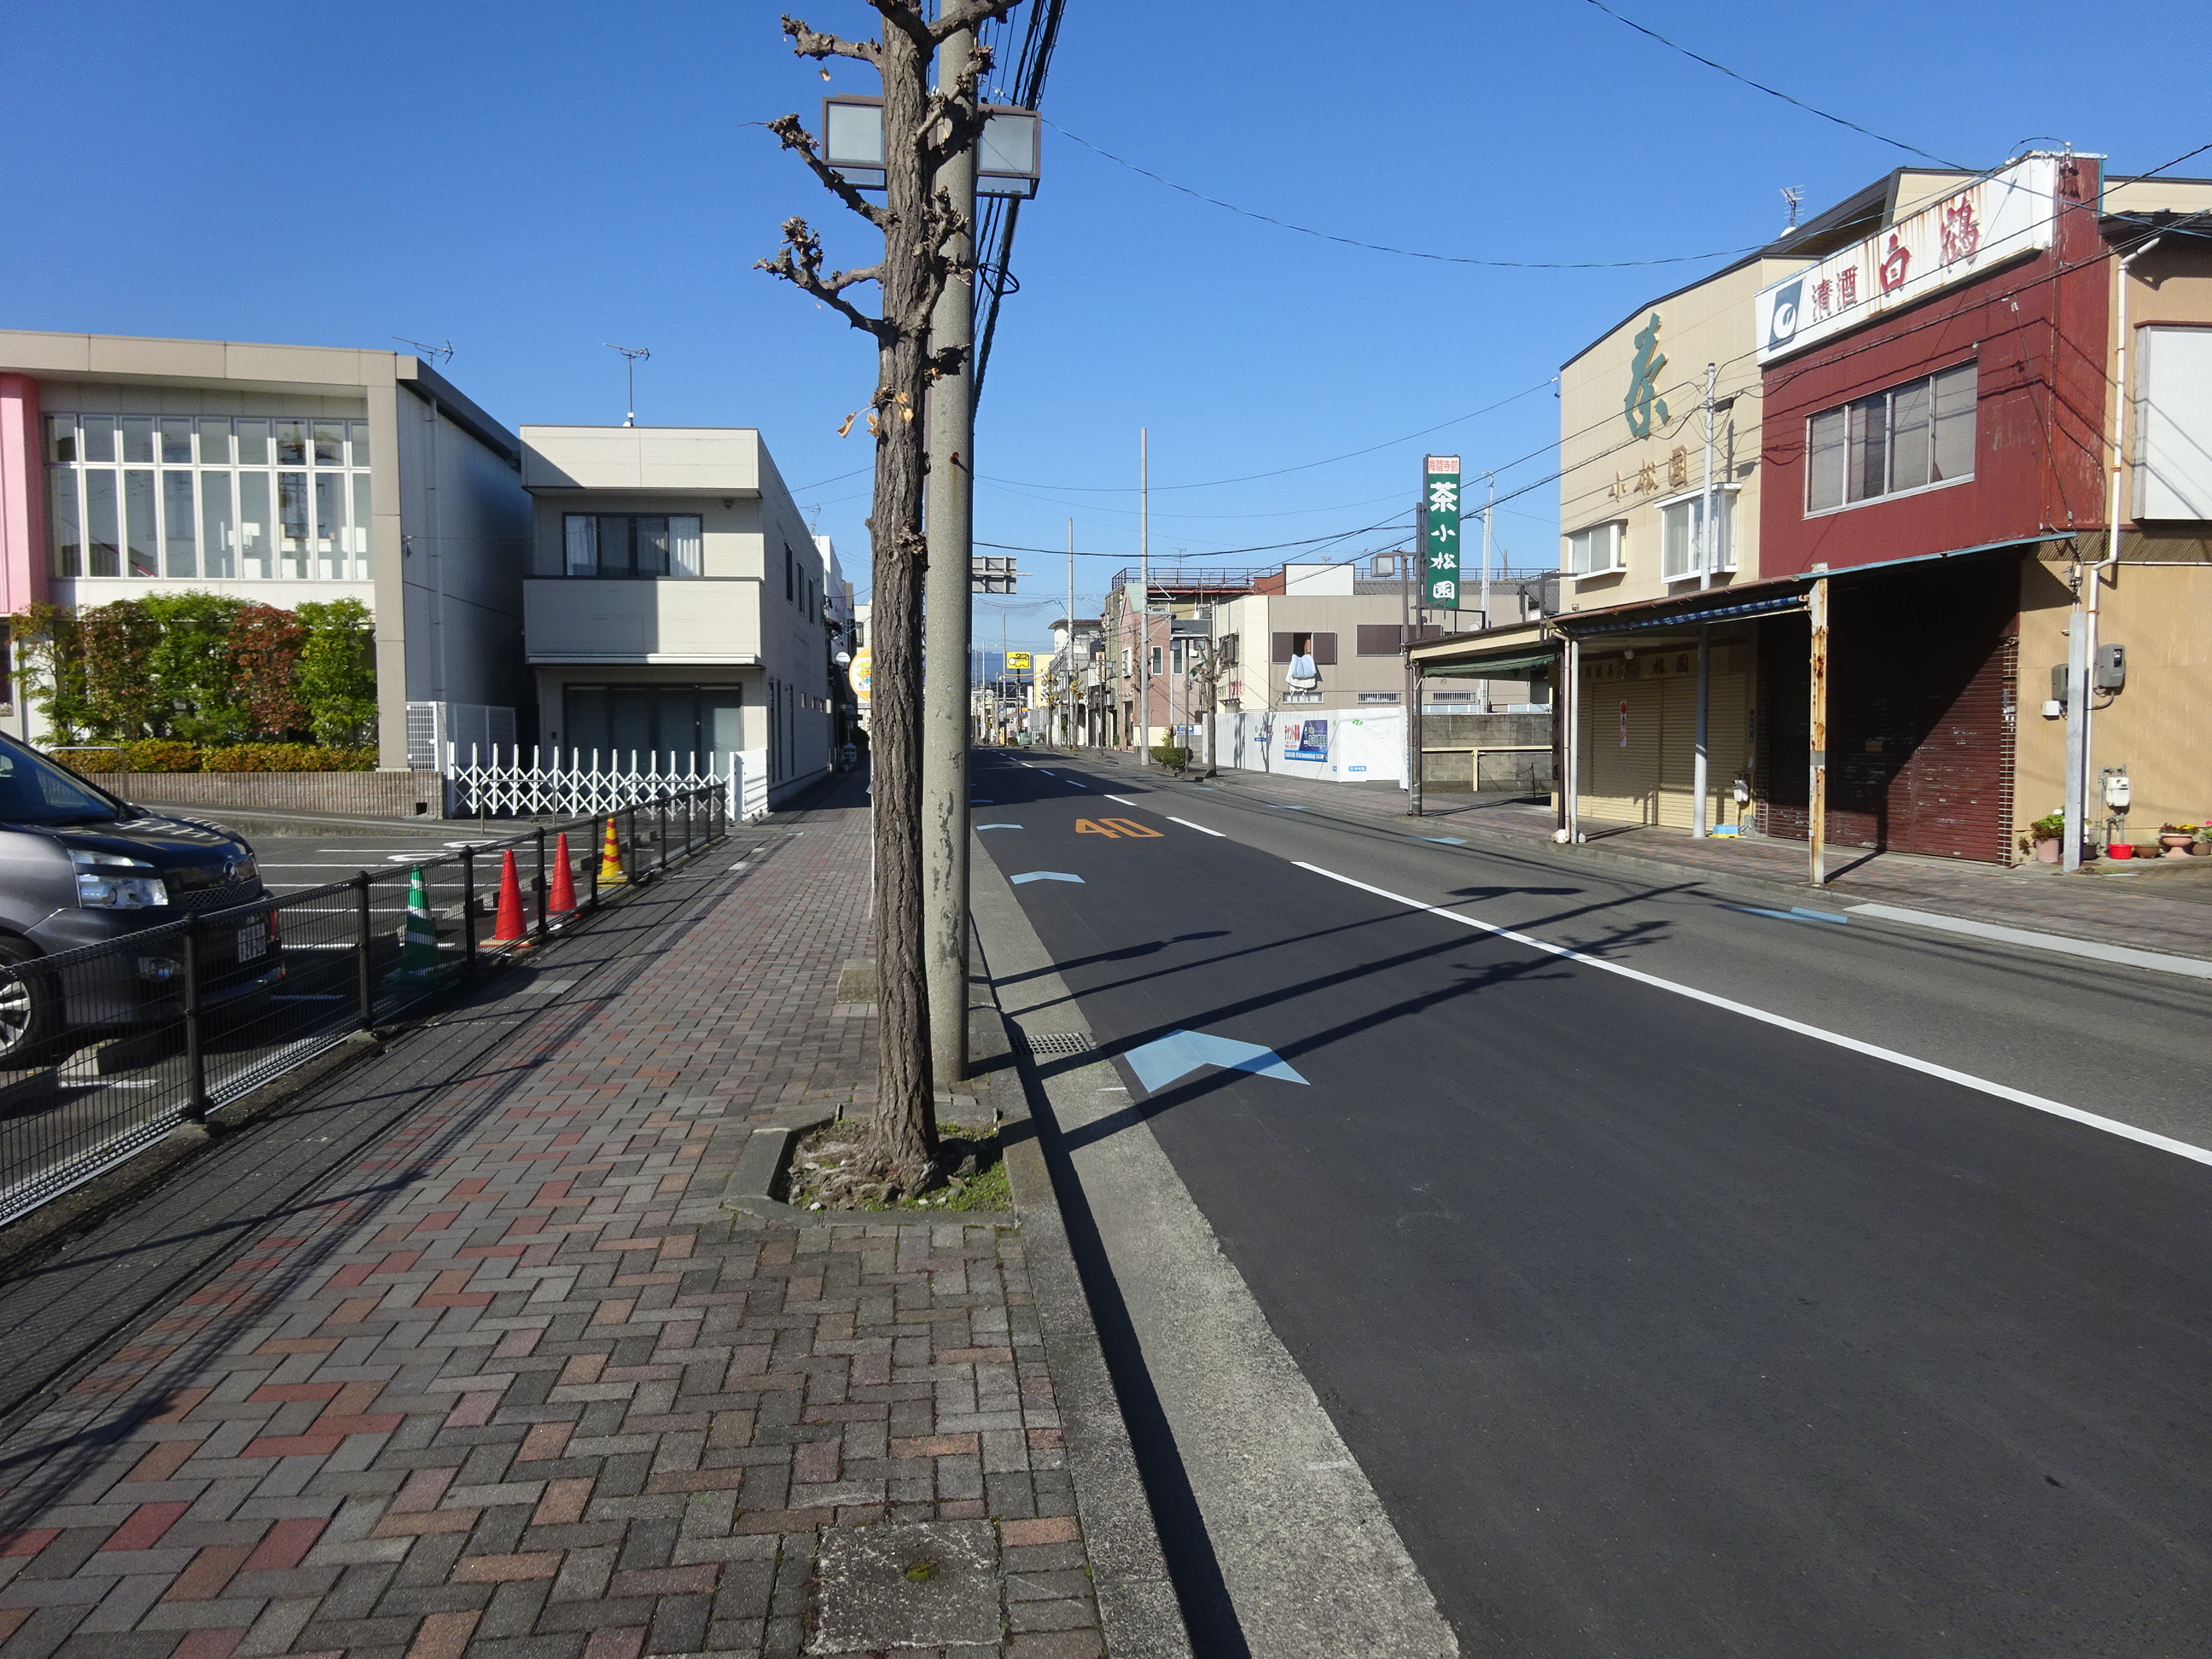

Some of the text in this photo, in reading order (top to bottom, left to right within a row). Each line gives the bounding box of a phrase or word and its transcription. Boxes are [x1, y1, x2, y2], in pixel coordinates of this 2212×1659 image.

[1812, 195, 1983, 323] 清酒 白鶴
[1608, 445, 1689, 504] 小松園
[1429, 481, 1458, 600] 茶 小松園
[1076, 818, 1165, 839] 40
